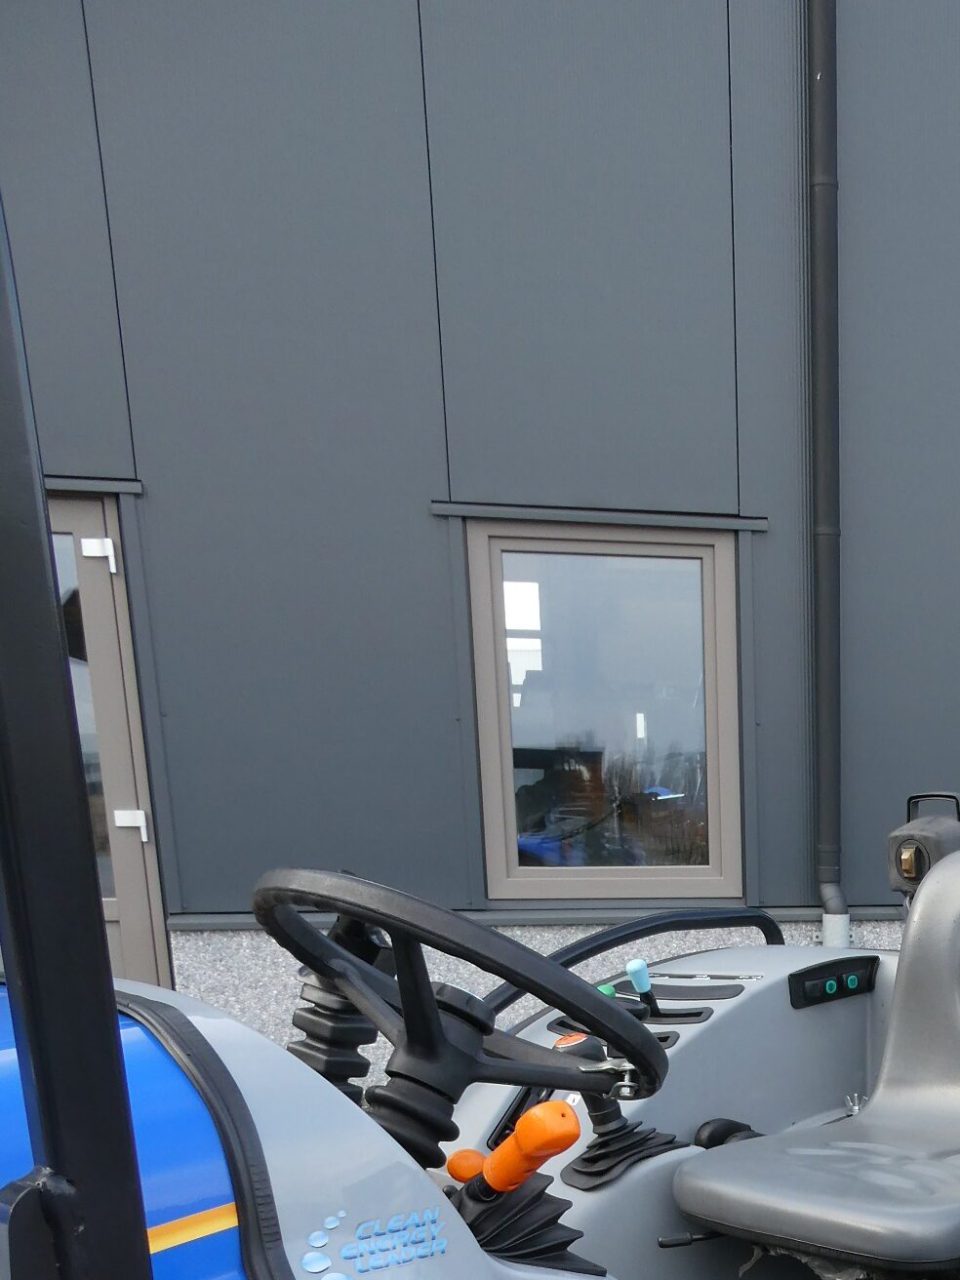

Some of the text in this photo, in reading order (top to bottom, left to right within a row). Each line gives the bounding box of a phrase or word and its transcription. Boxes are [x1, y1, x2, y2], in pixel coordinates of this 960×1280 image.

[340, 1221, 446, 1260] ENERGY
[355, 1206, 440, 1241] CLEAN
[354, 1237, 448, 1274] LEADER
